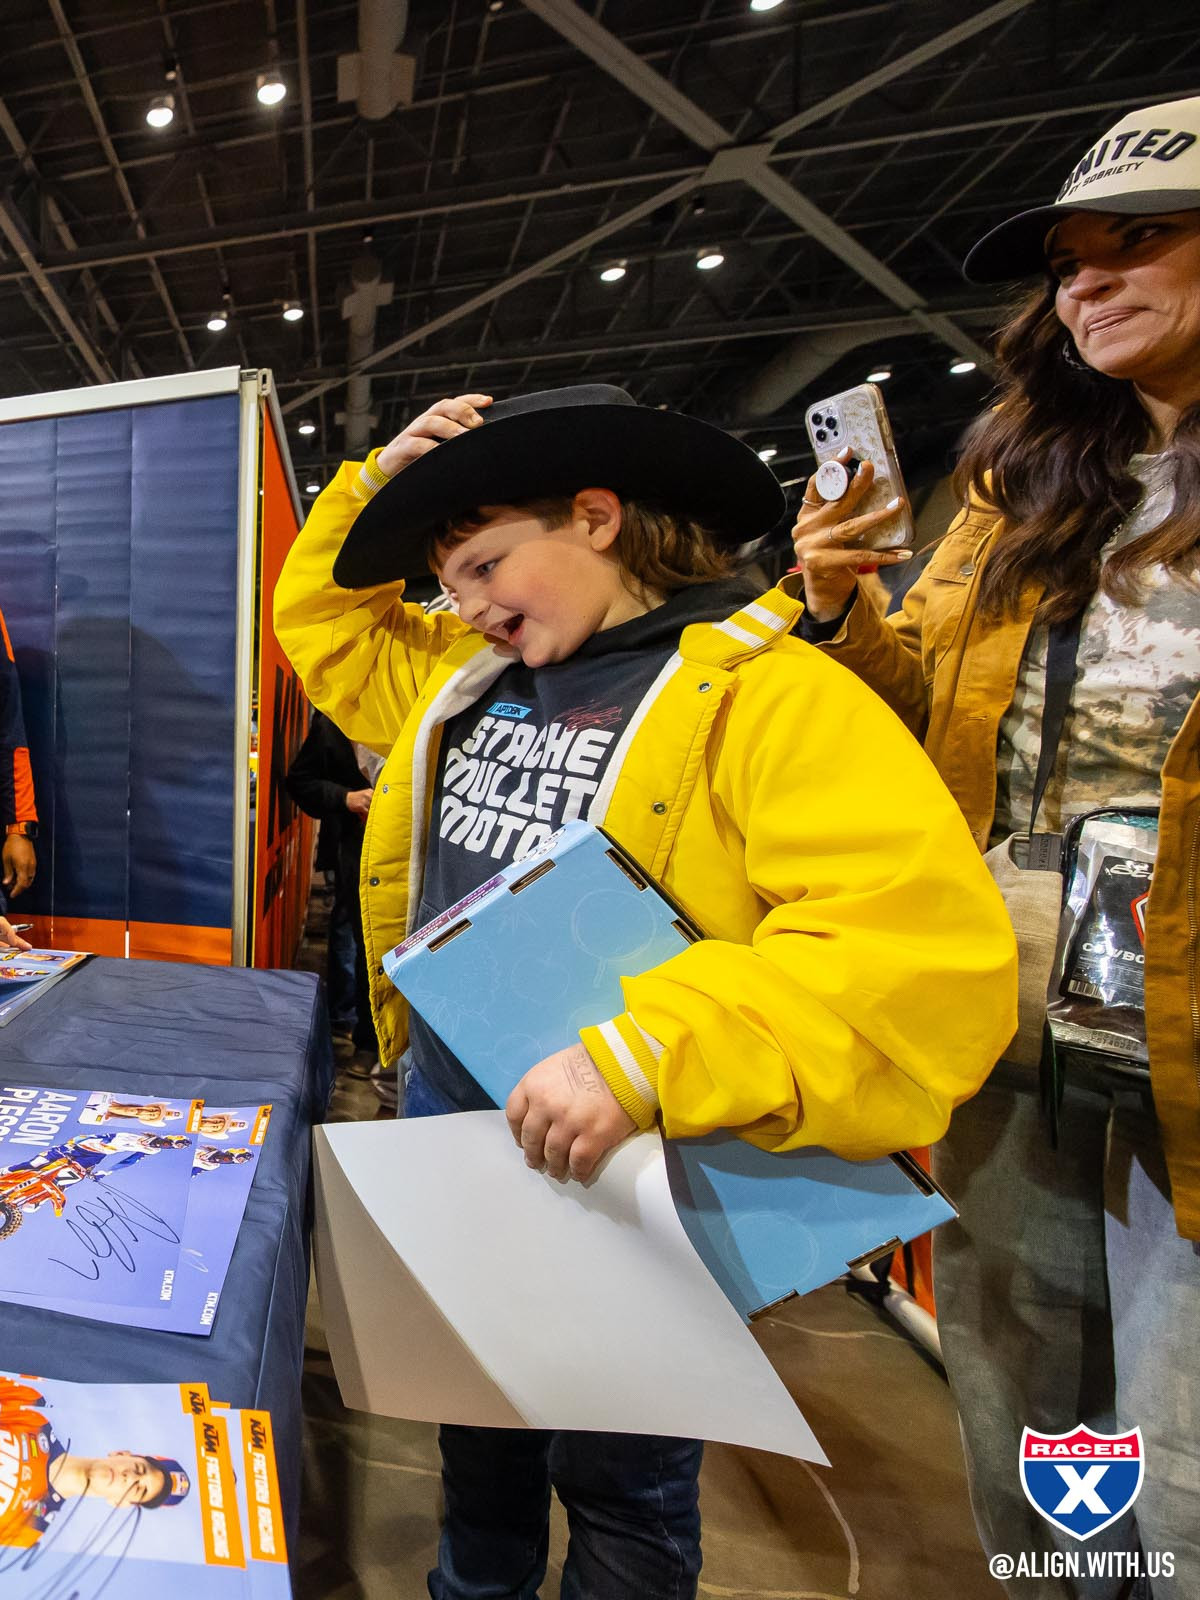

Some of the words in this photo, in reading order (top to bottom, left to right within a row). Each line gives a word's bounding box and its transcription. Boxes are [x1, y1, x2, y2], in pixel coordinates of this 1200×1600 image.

[1082, 161, 1144, 187] SOBRIETY
[462, 715, 616, 776] STACHE
[443, 747, 599, 825] MULLET
[440, 795, 552, 862] MOTO
[9, 1089, 78, 1147] AARON
[160, 1269, 175, 1301] KTM.COM
[199, 1291, 219, 1326] KTM.COM
[202, 1422, 220, 1454] KTM
[249, 1418, 267, 1450] KTM
